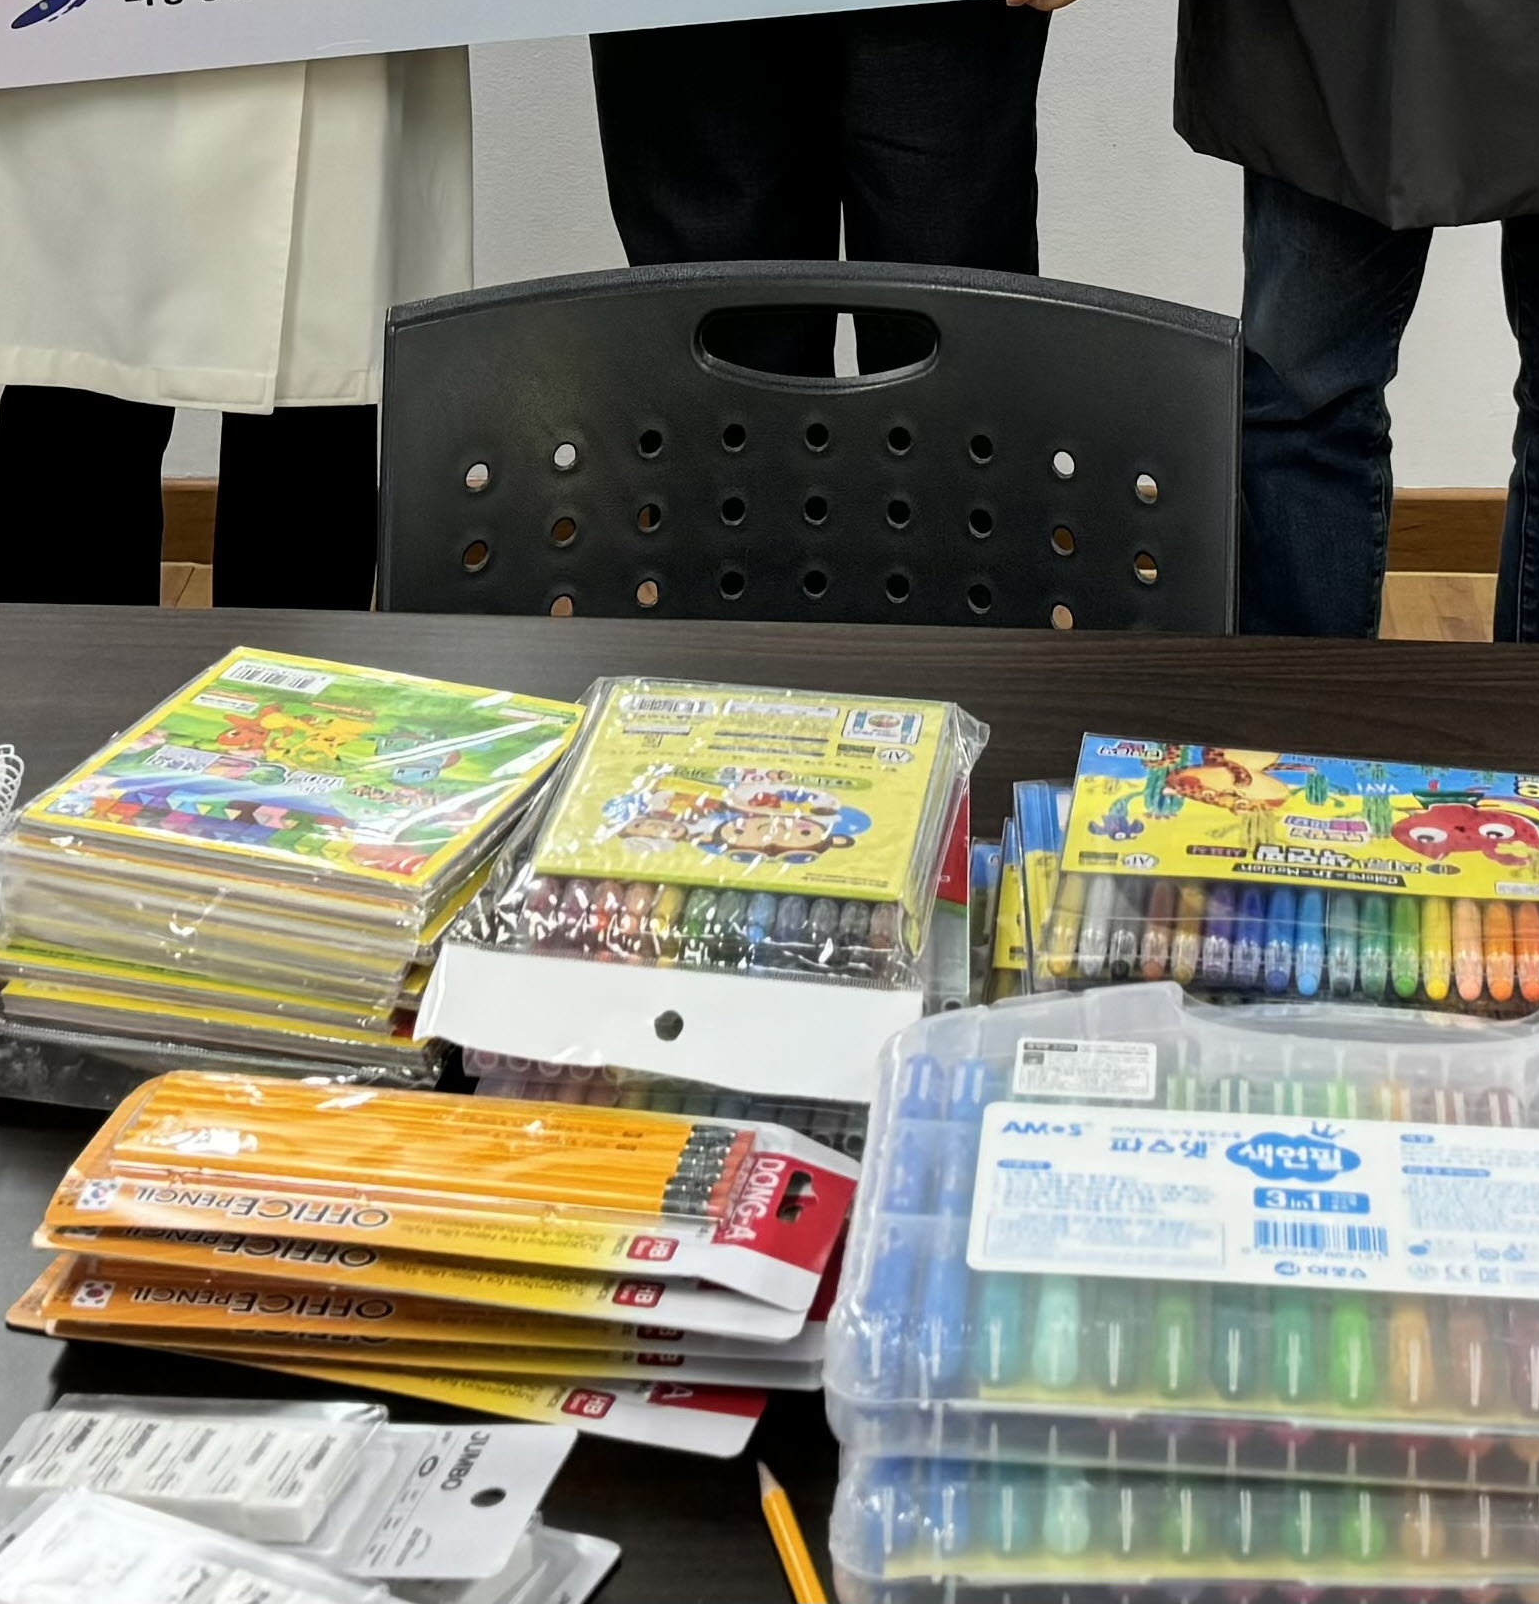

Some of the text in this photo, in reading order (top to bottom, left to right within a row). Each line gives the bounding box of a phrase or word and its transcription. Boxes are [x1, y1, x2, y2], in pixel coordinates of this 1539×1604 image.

[1238, 1143, 1344, 1173] 색연필
[135, 1185, 392, 1229] OFFICE PENCIL
[734, 1156, 784, 1243] DONG-A
[214, 1233, 378, 1269] OFFICE
[128, 1284, 395, 1322] OFFICE PENCIL
[439, 1429, 494, 1494] JUMBO
